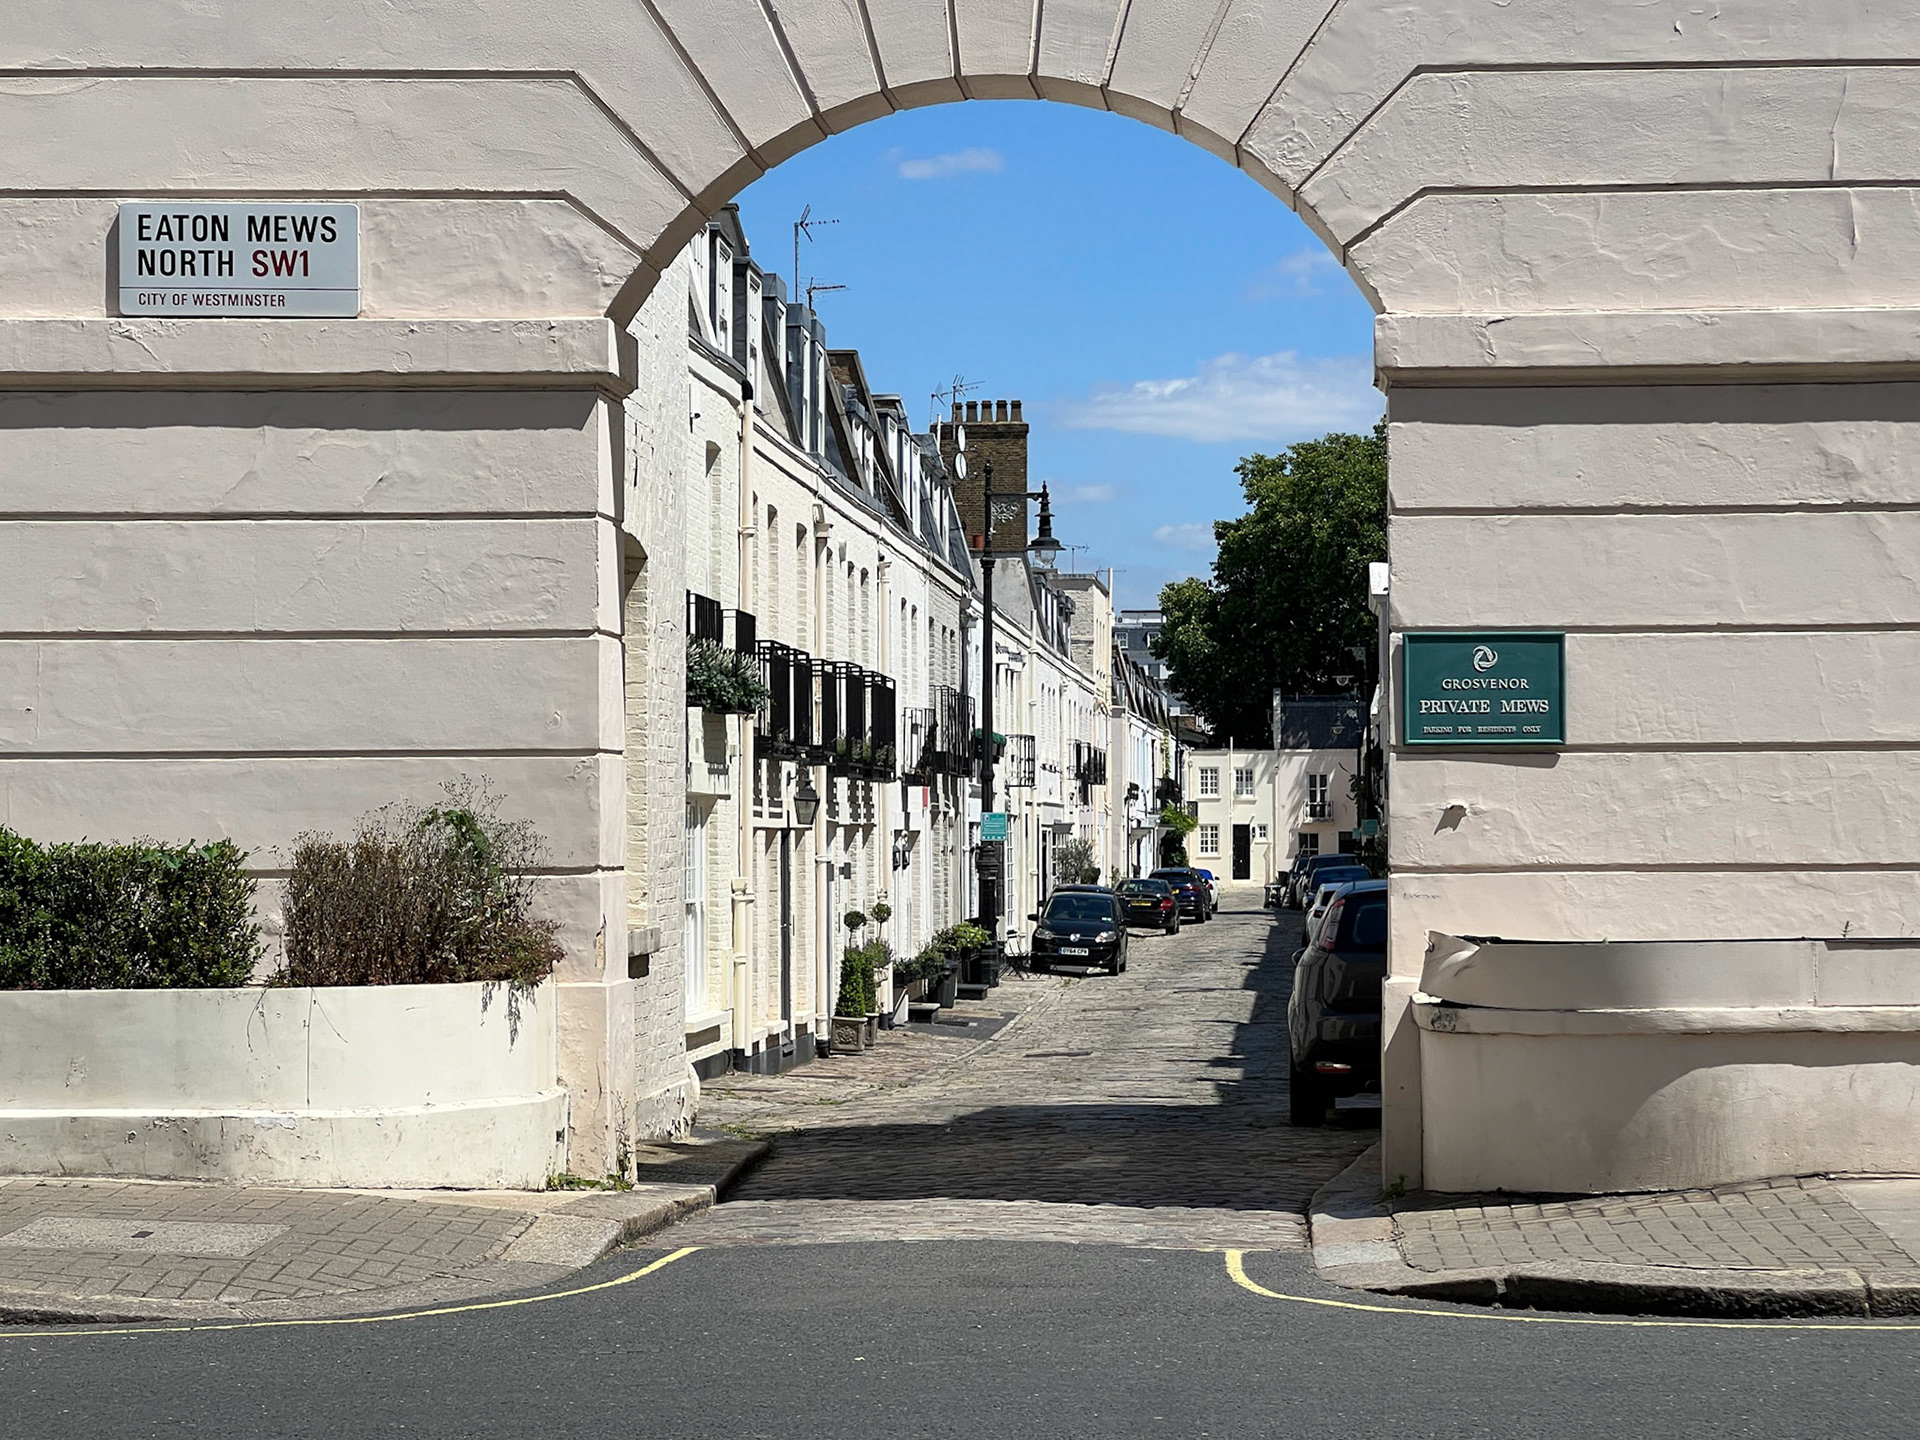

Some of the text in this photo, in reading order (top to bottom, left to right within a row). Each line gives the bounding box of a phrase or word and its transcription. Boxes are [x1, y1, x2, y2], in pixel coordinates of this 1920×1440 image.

[138, 214, 337, 243] EATON MEWS
[138, 249, 309, 277] NORTH SW1
[138, 293, 285, 307] CITY OF WESTMINSTER
[1442, 678, 1530, 690] GROSVENOR
[1419, 700, 1550, 714] PRIVATE MEWS
